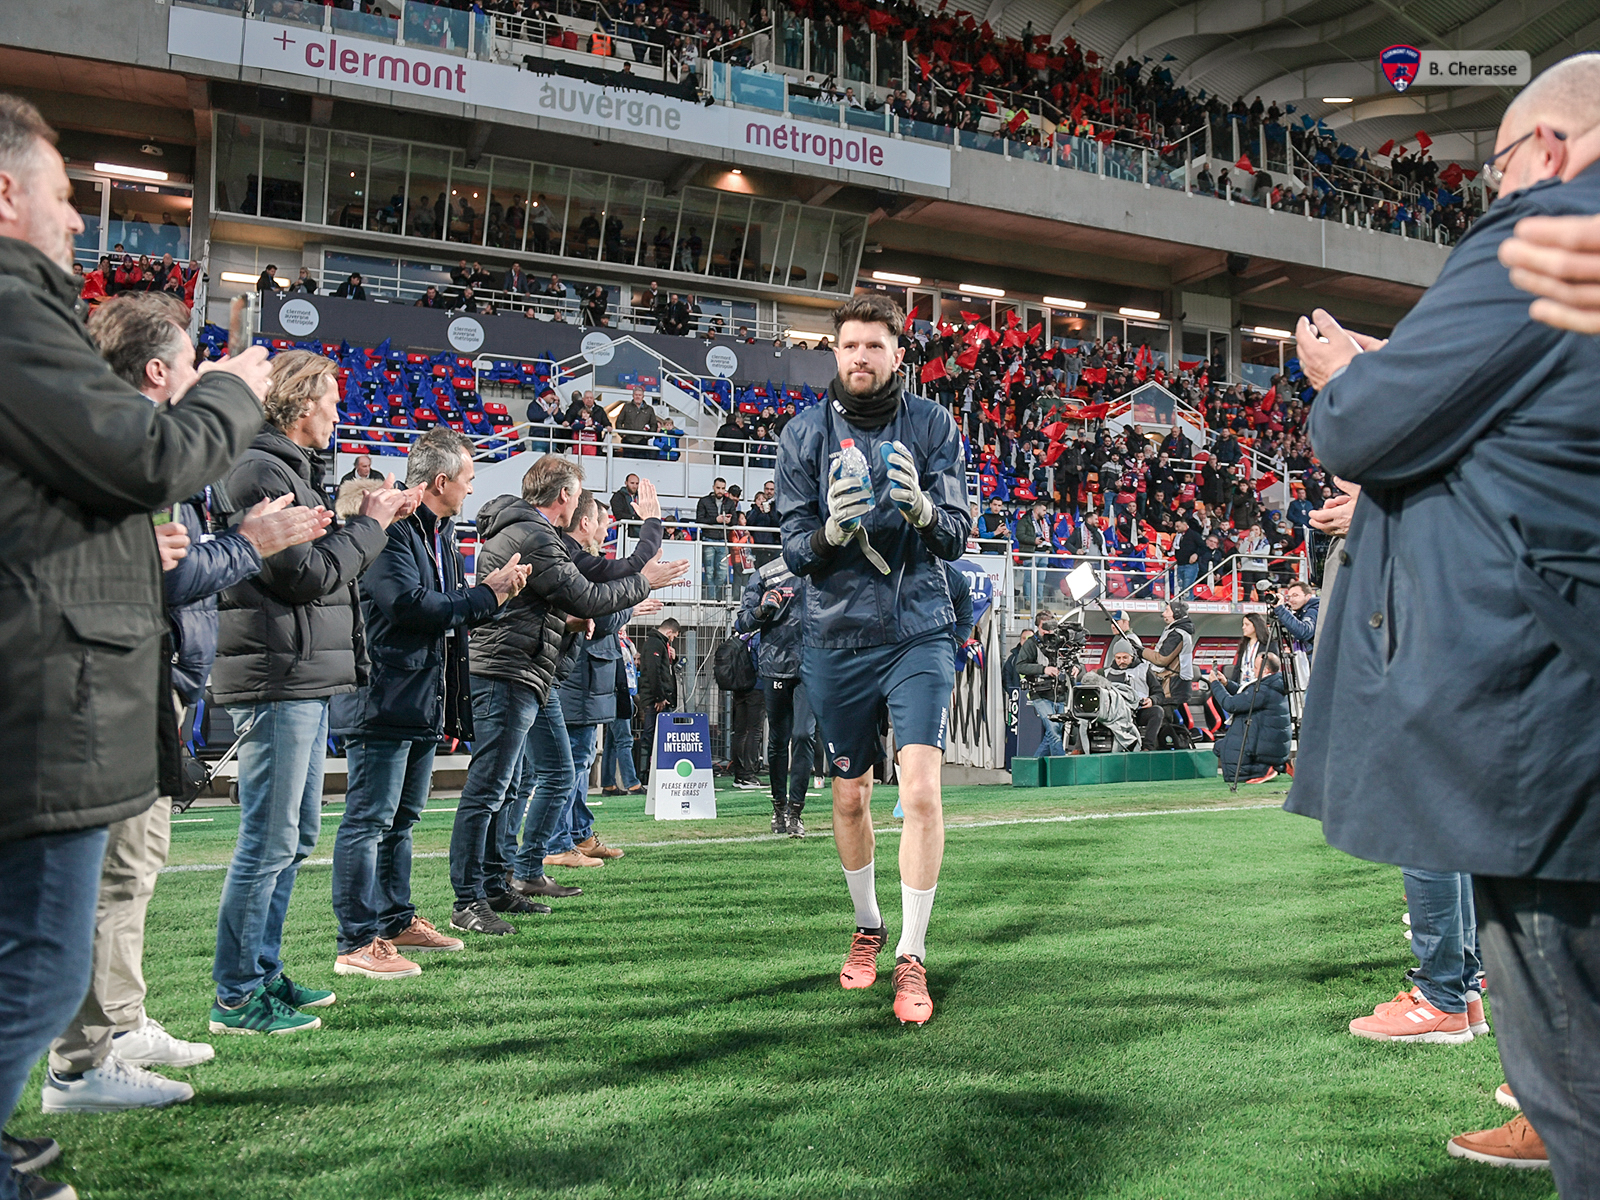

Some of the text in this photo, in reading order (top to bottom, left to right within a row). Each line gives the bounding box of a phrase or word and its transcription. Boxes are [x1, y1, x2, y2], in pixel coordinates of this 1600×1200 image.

[305, 39, 466, 93] clermont
[538, 85, 681, 131] auvergne
[746, 122, 884, 166] métropole
[286, 308, 311, 316] clermont
[773, 681, 783, 689] EG
[666, 732, 700, 742] PELOUSE
[664, 742, 703, 752] INTERDITE
[661, 782, 682, 790] PLEASE
[697, 781, 708, 789] OFF
